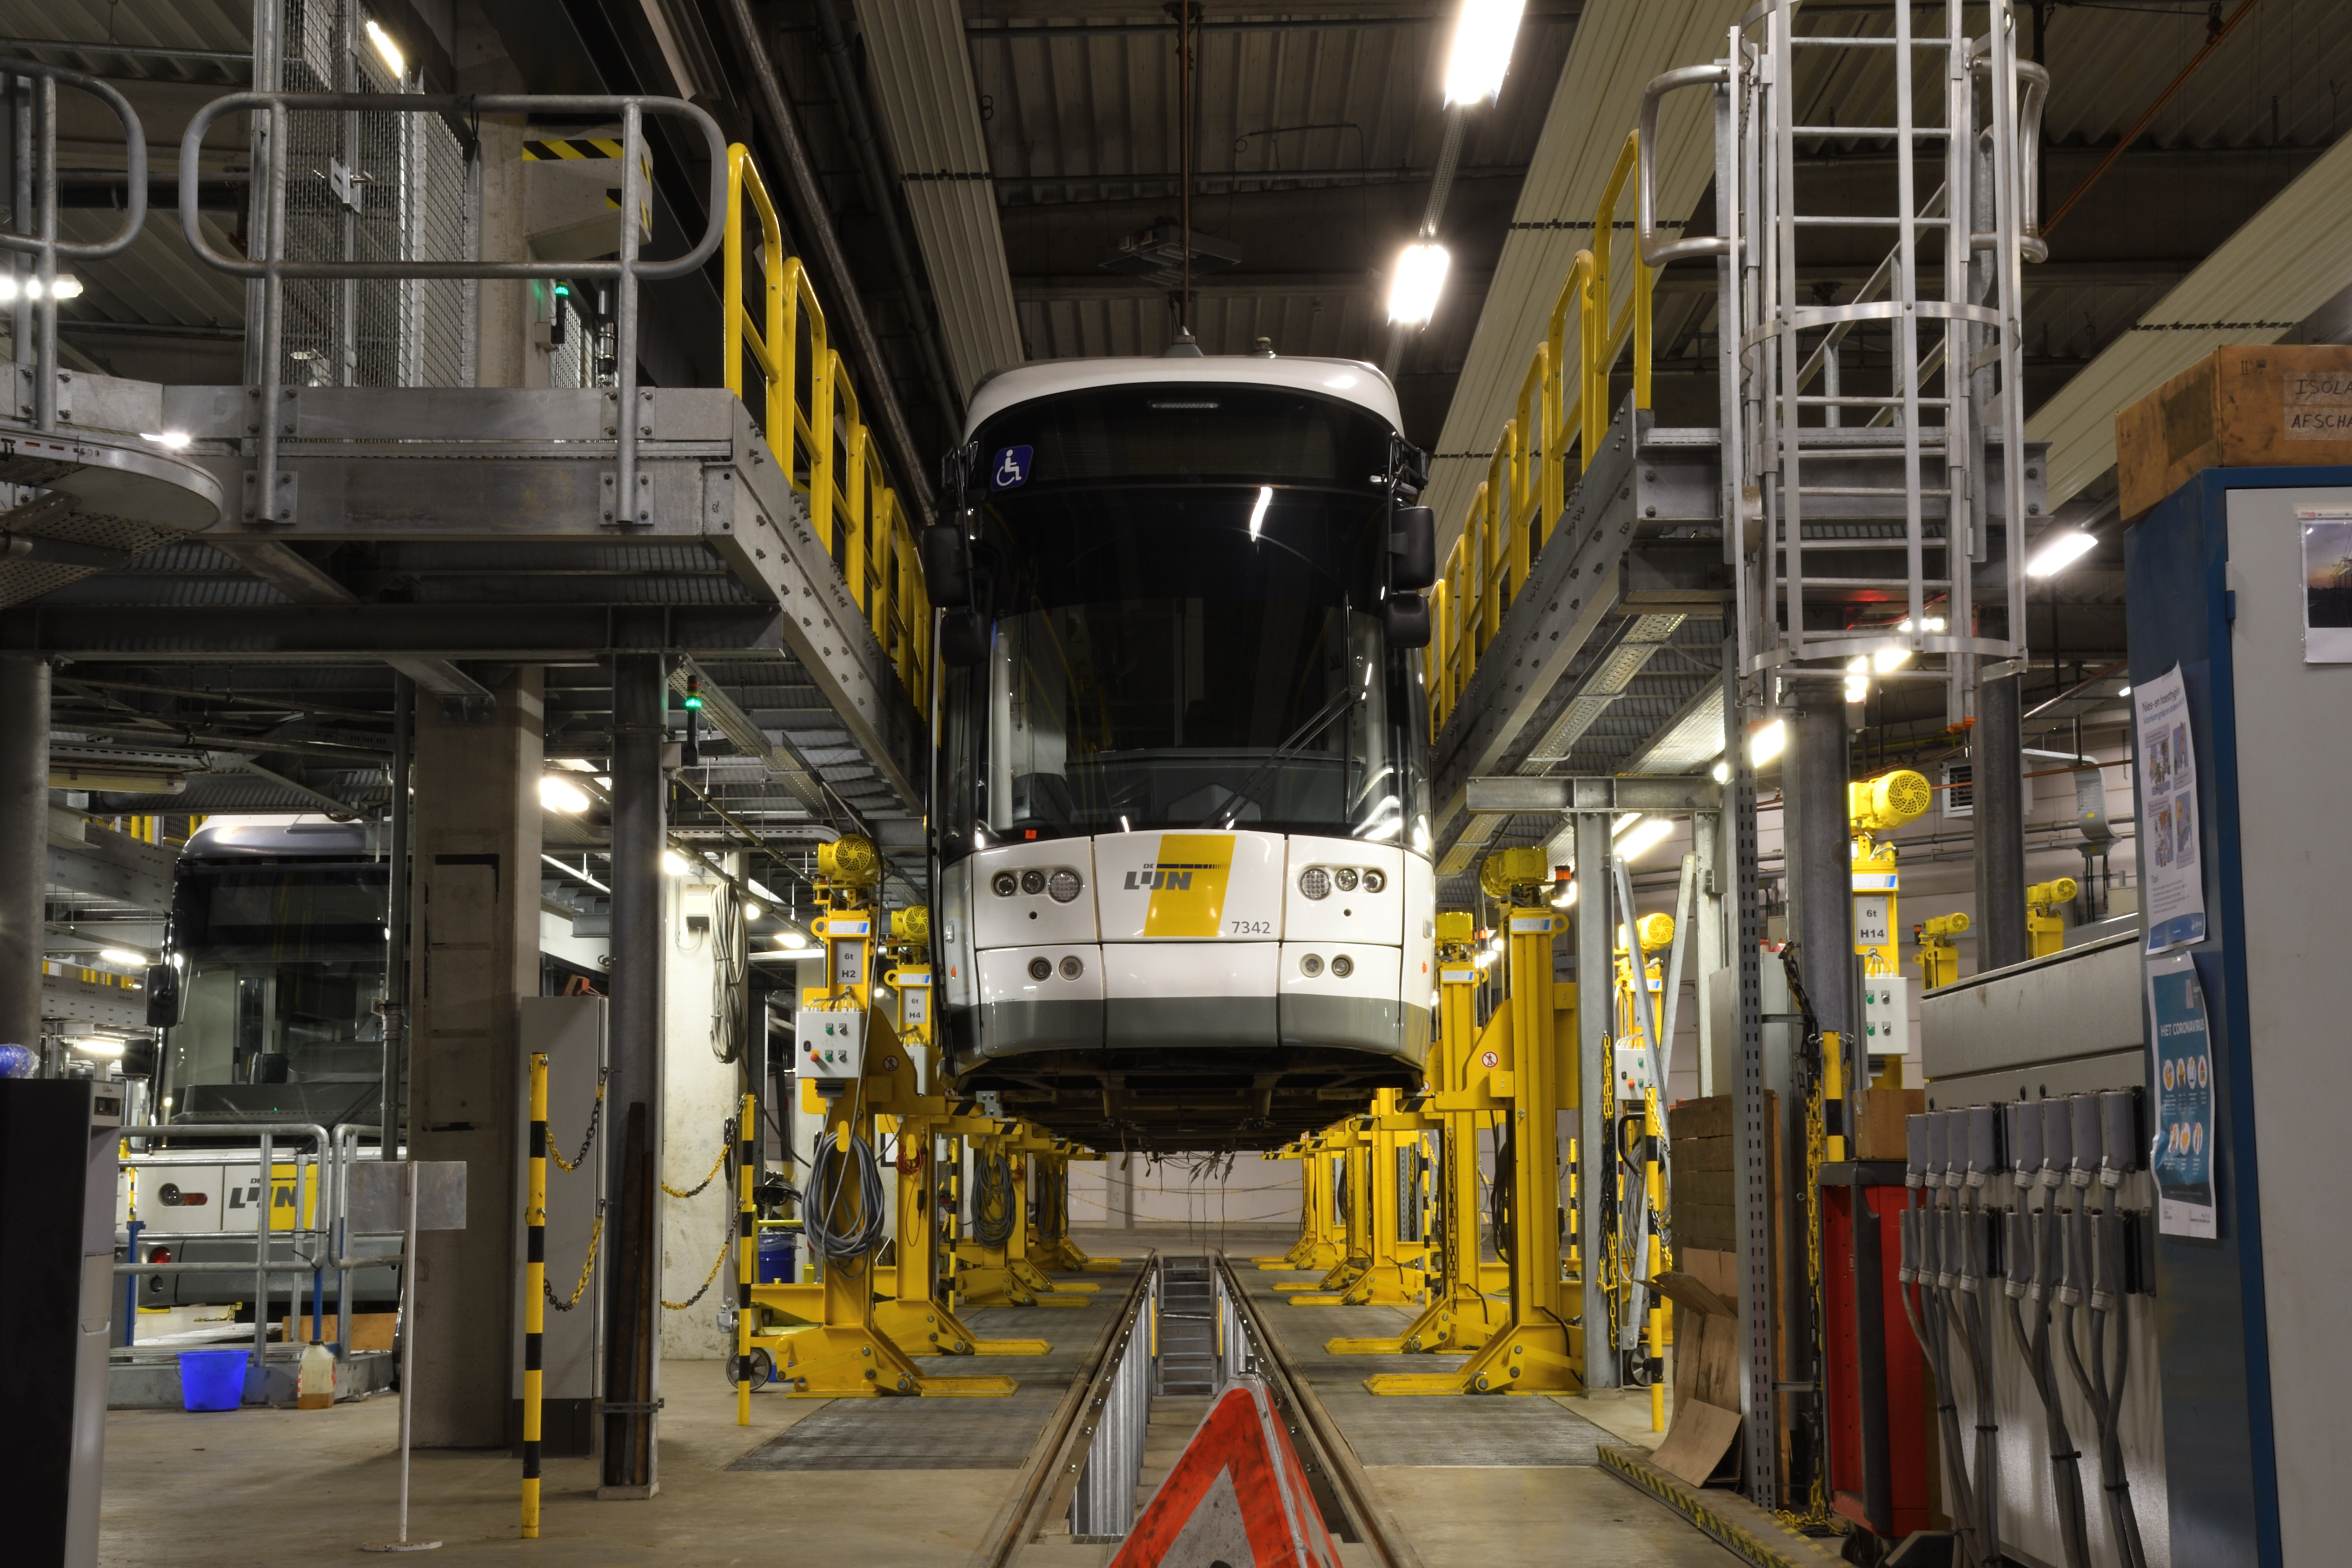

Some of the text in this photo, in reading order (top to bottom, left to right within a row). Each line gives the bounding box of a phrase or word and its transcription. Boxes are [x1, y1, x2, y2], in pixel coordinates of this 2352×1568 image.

[1123, 871, 1193, 890] LIJN
[1231, 921, 1270, 934] 7342
[1860, 929, 1885, 938] H14
[2160, 1018, 2205, 1036] HET CORONAVIRUS
